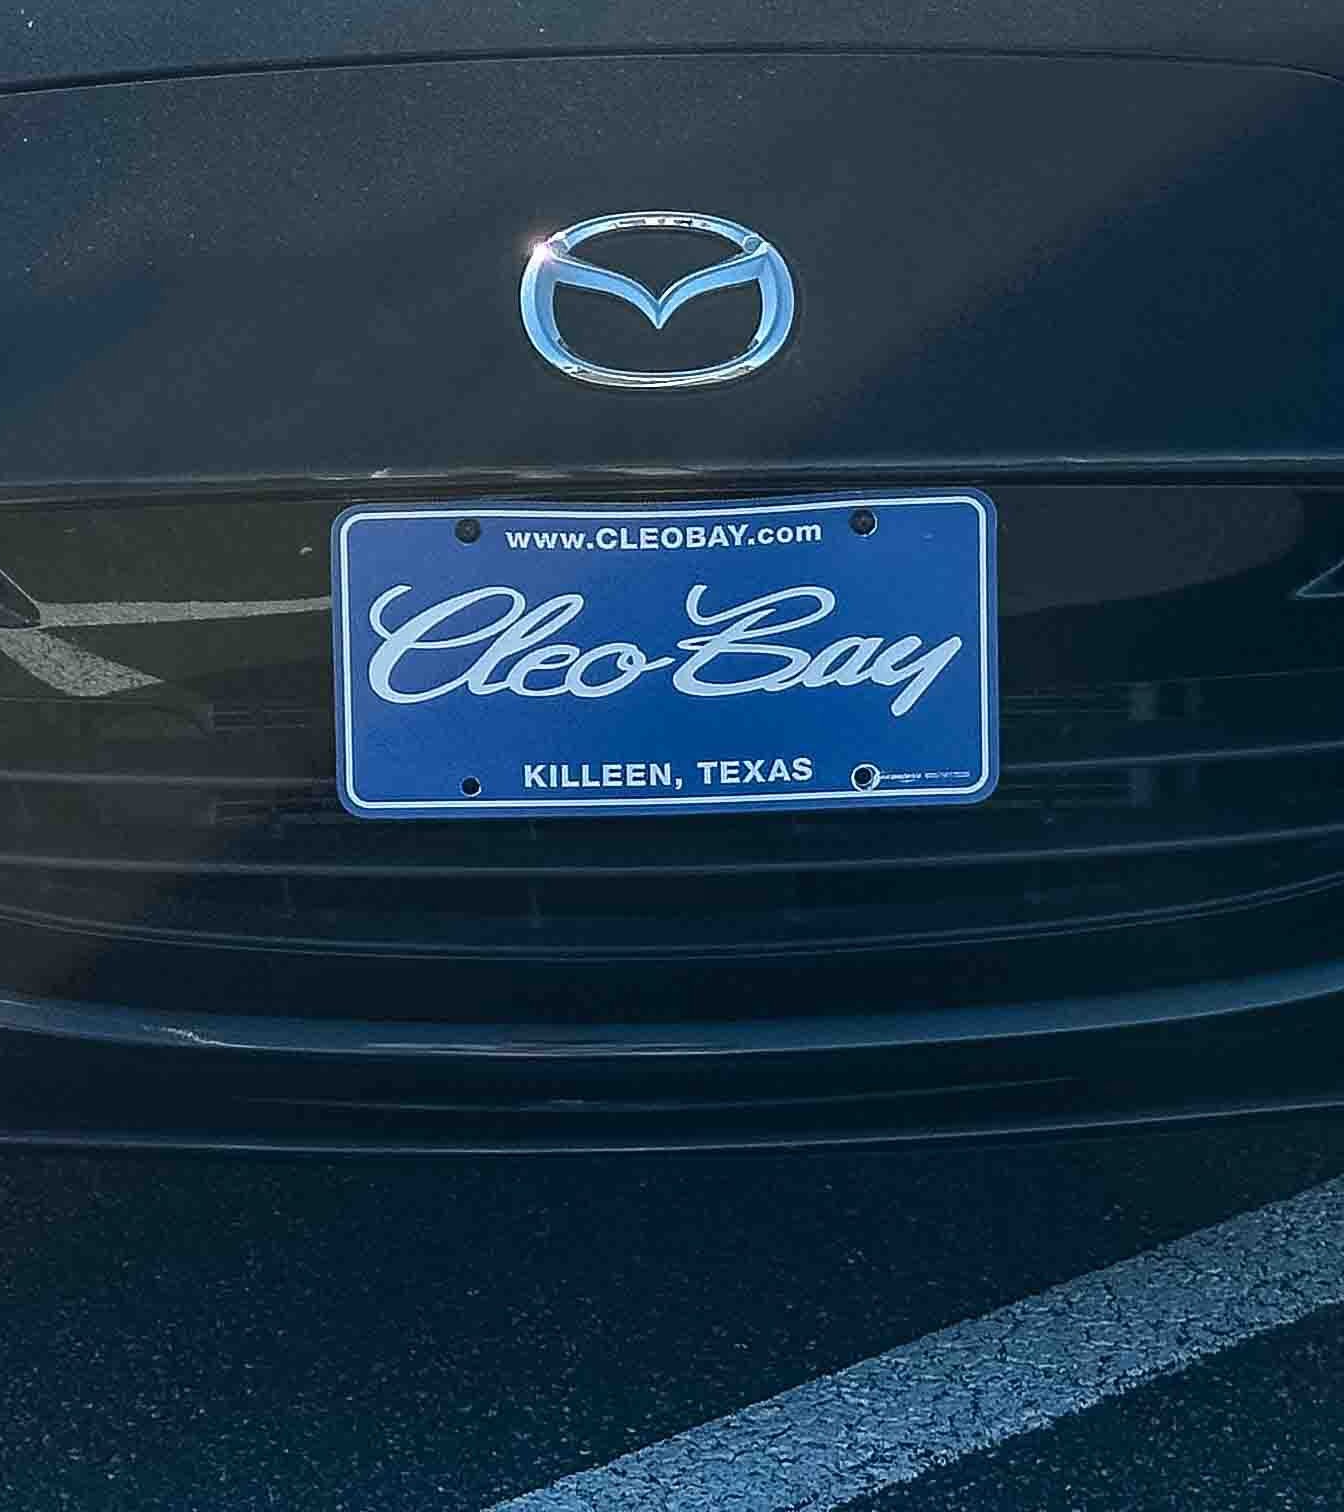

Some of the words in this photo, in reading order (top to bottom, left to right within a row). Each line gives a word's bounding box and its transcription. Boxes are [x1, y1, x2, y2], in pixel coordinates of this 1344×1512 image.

[504, 524, 822, 551] www.CLEOBAY.com
[367, 584, 676, 705] Cleo
[672, 583, 964, 718] Bay
[523, 763, 682, 790] KILLEEN,
[697, 757, 814, 785] TEXAS
